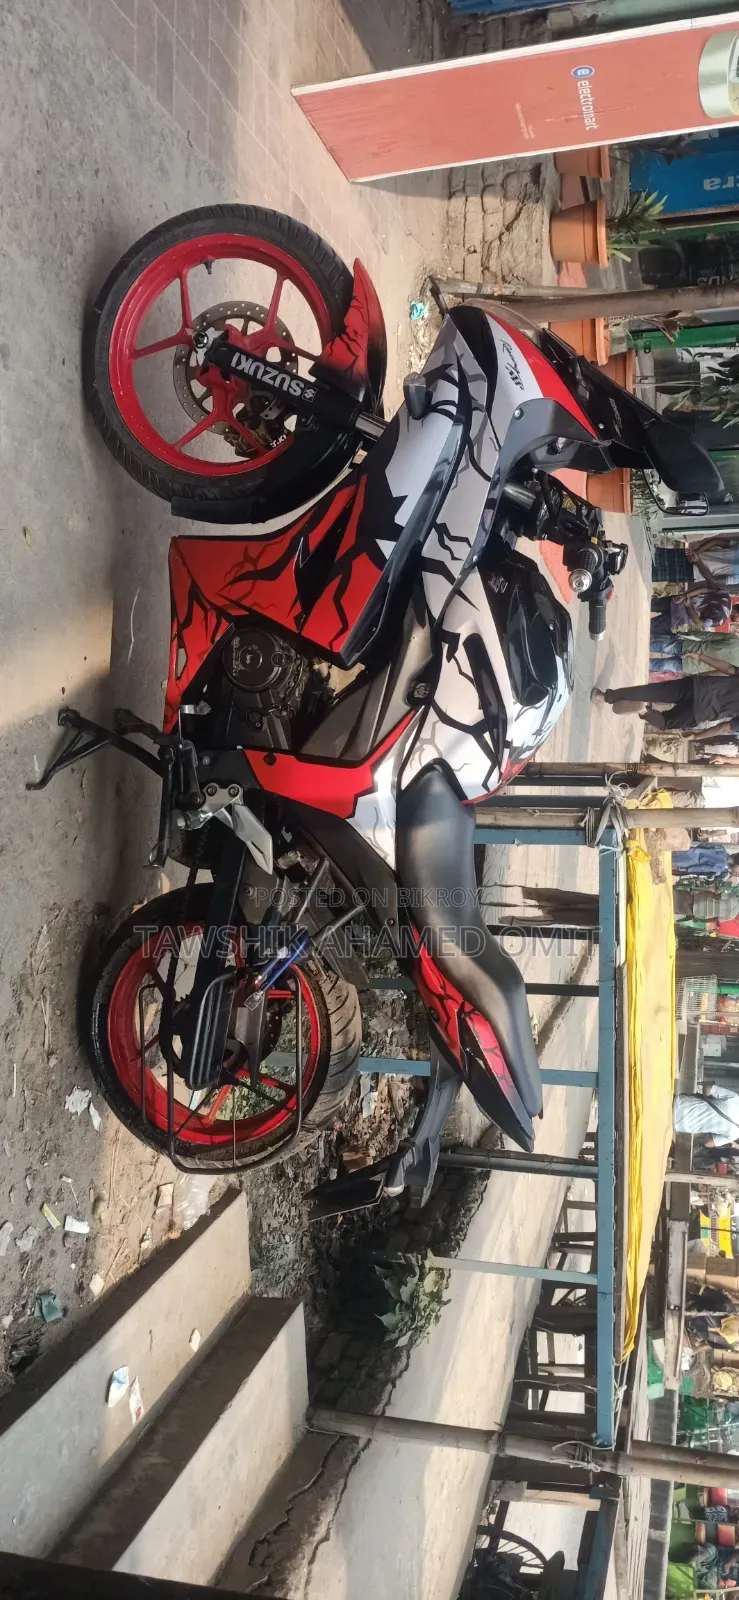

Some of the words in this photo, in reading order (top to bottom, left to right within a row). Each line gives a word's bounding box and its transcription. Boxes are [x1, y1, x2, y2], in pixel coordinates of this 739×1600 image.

[577, 80, 599, 130] electromart
[703, 175, 739, 191] ra
[230, 351, 304, 397] SUZUKI
